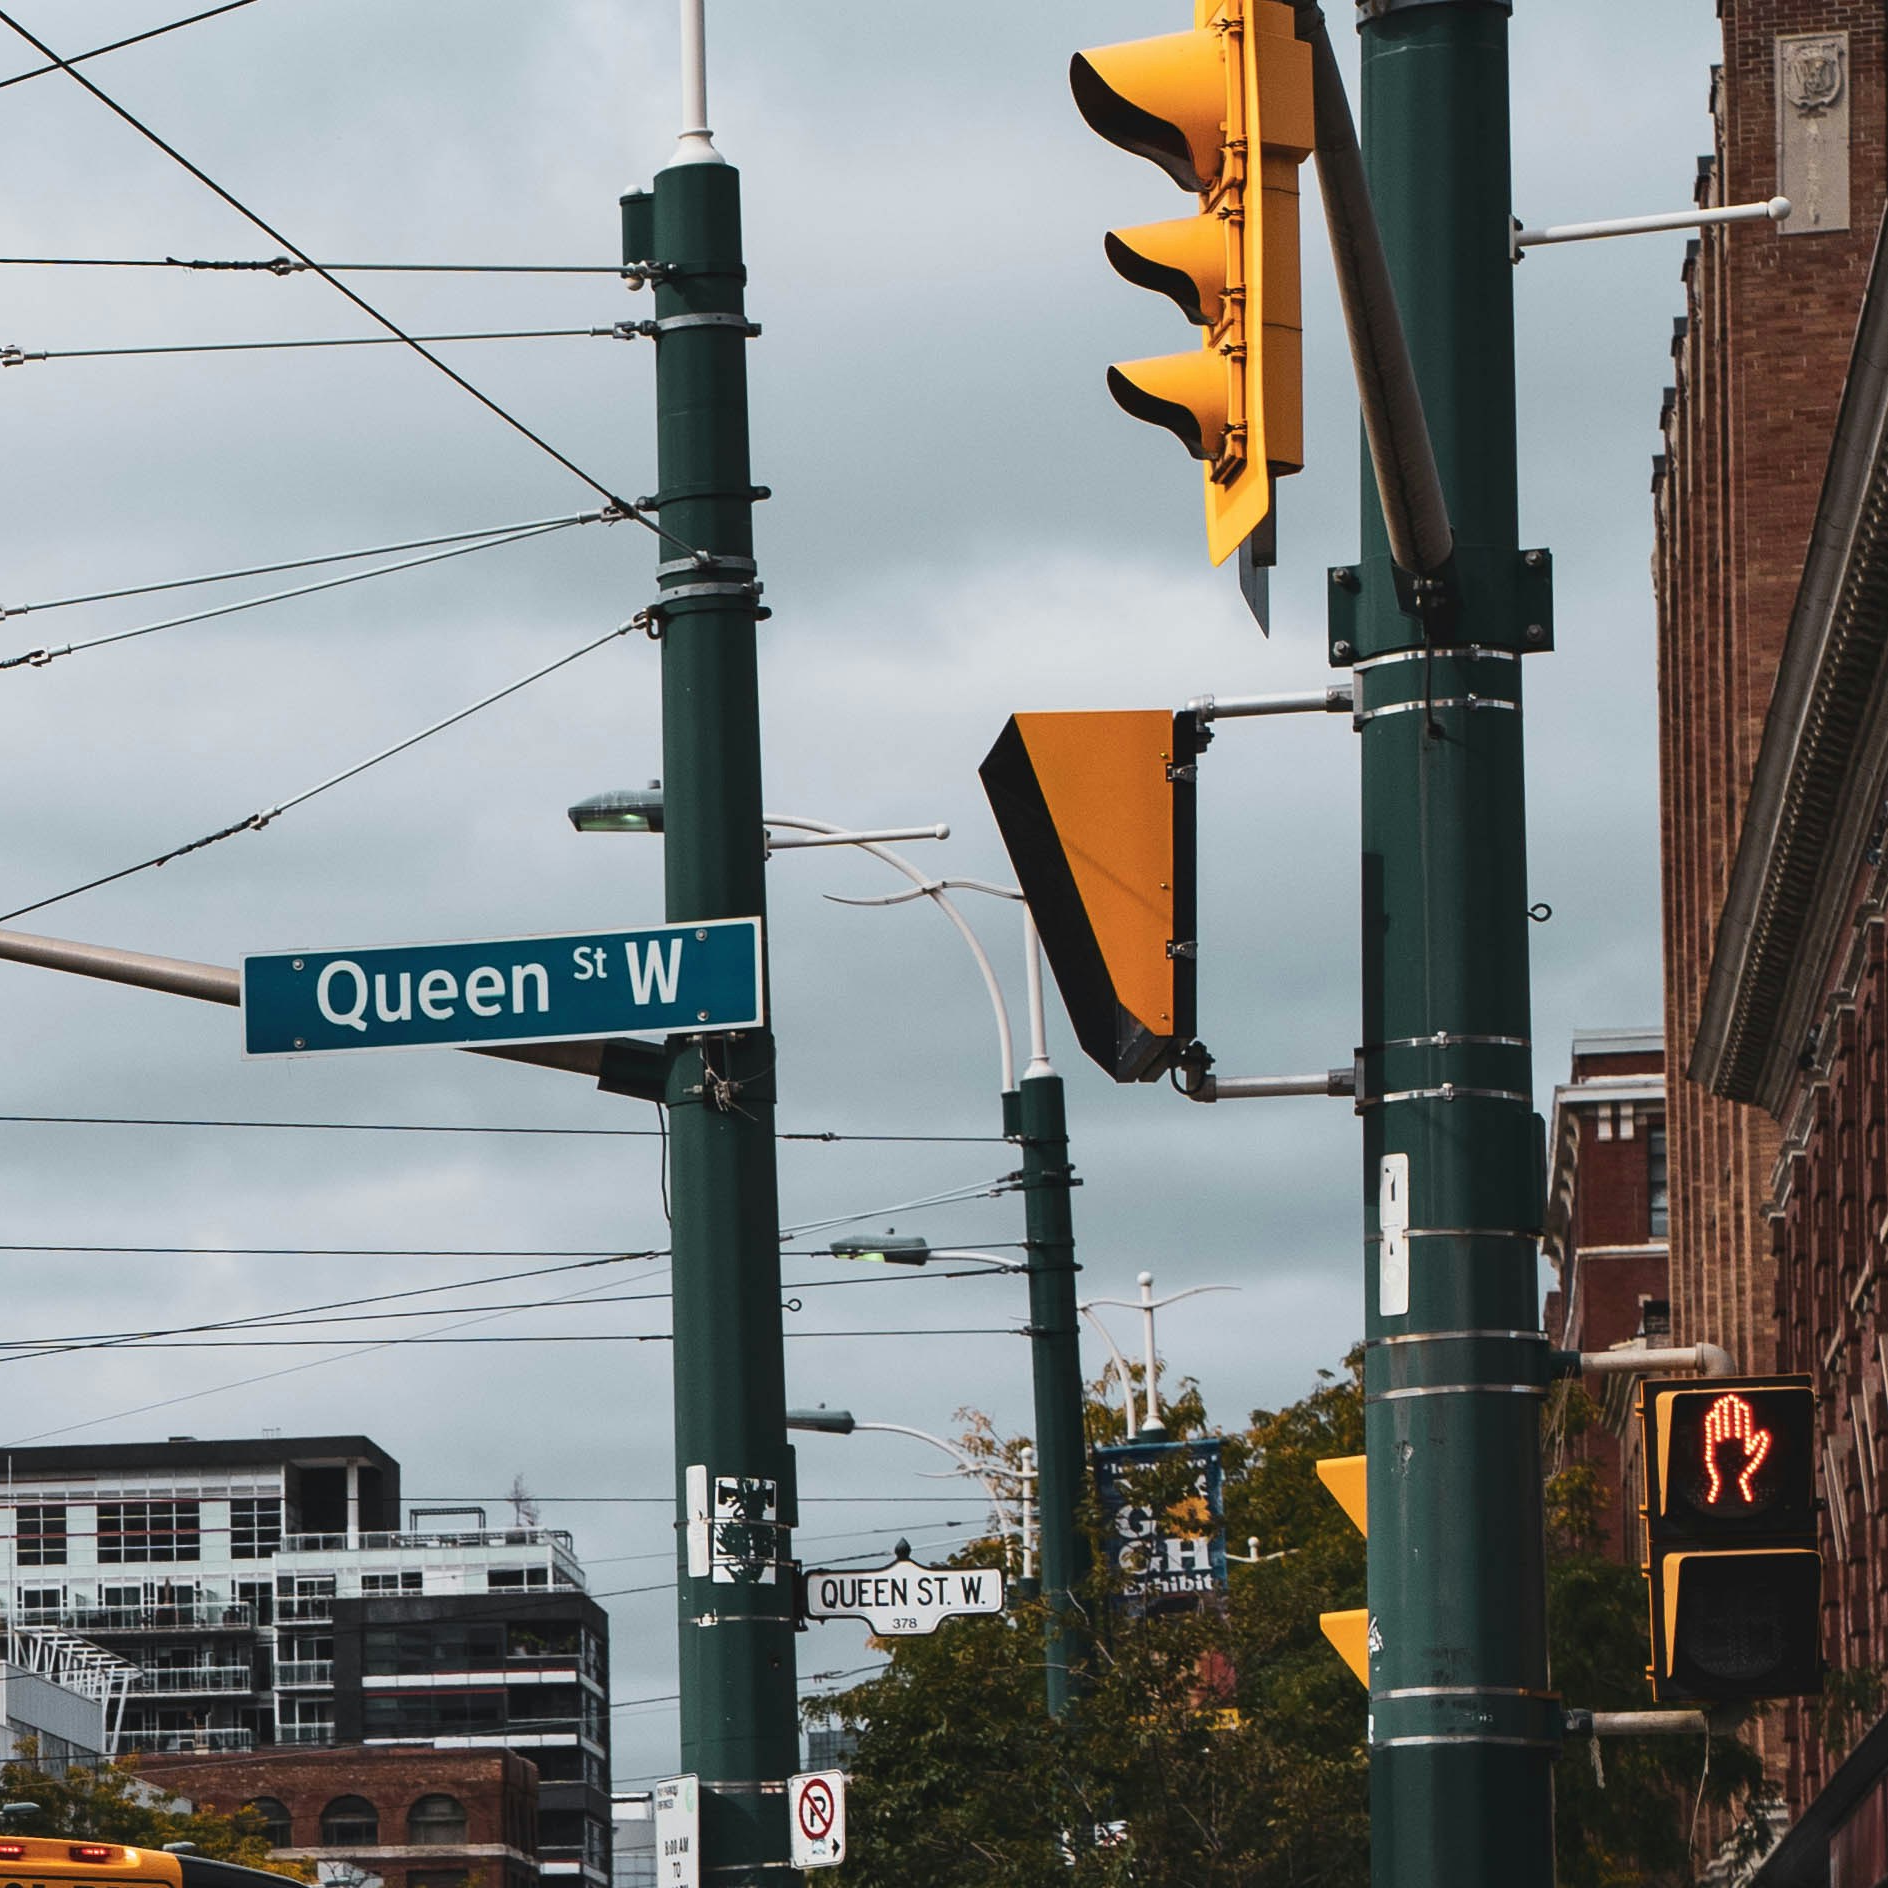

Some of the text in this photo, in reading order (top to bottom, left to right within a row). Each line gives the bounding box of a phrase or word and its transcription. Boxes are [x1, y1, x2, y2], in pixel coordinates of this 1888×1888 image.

[317, 938, 684, 1033] Queen St W
[822, 1576, 986, 1609] QUEEN ST. W.
[893, 1618, 918, 1630] 378
[679, 1836, 689, 1853] AM
[673, 1861, 681, 1878] TO
